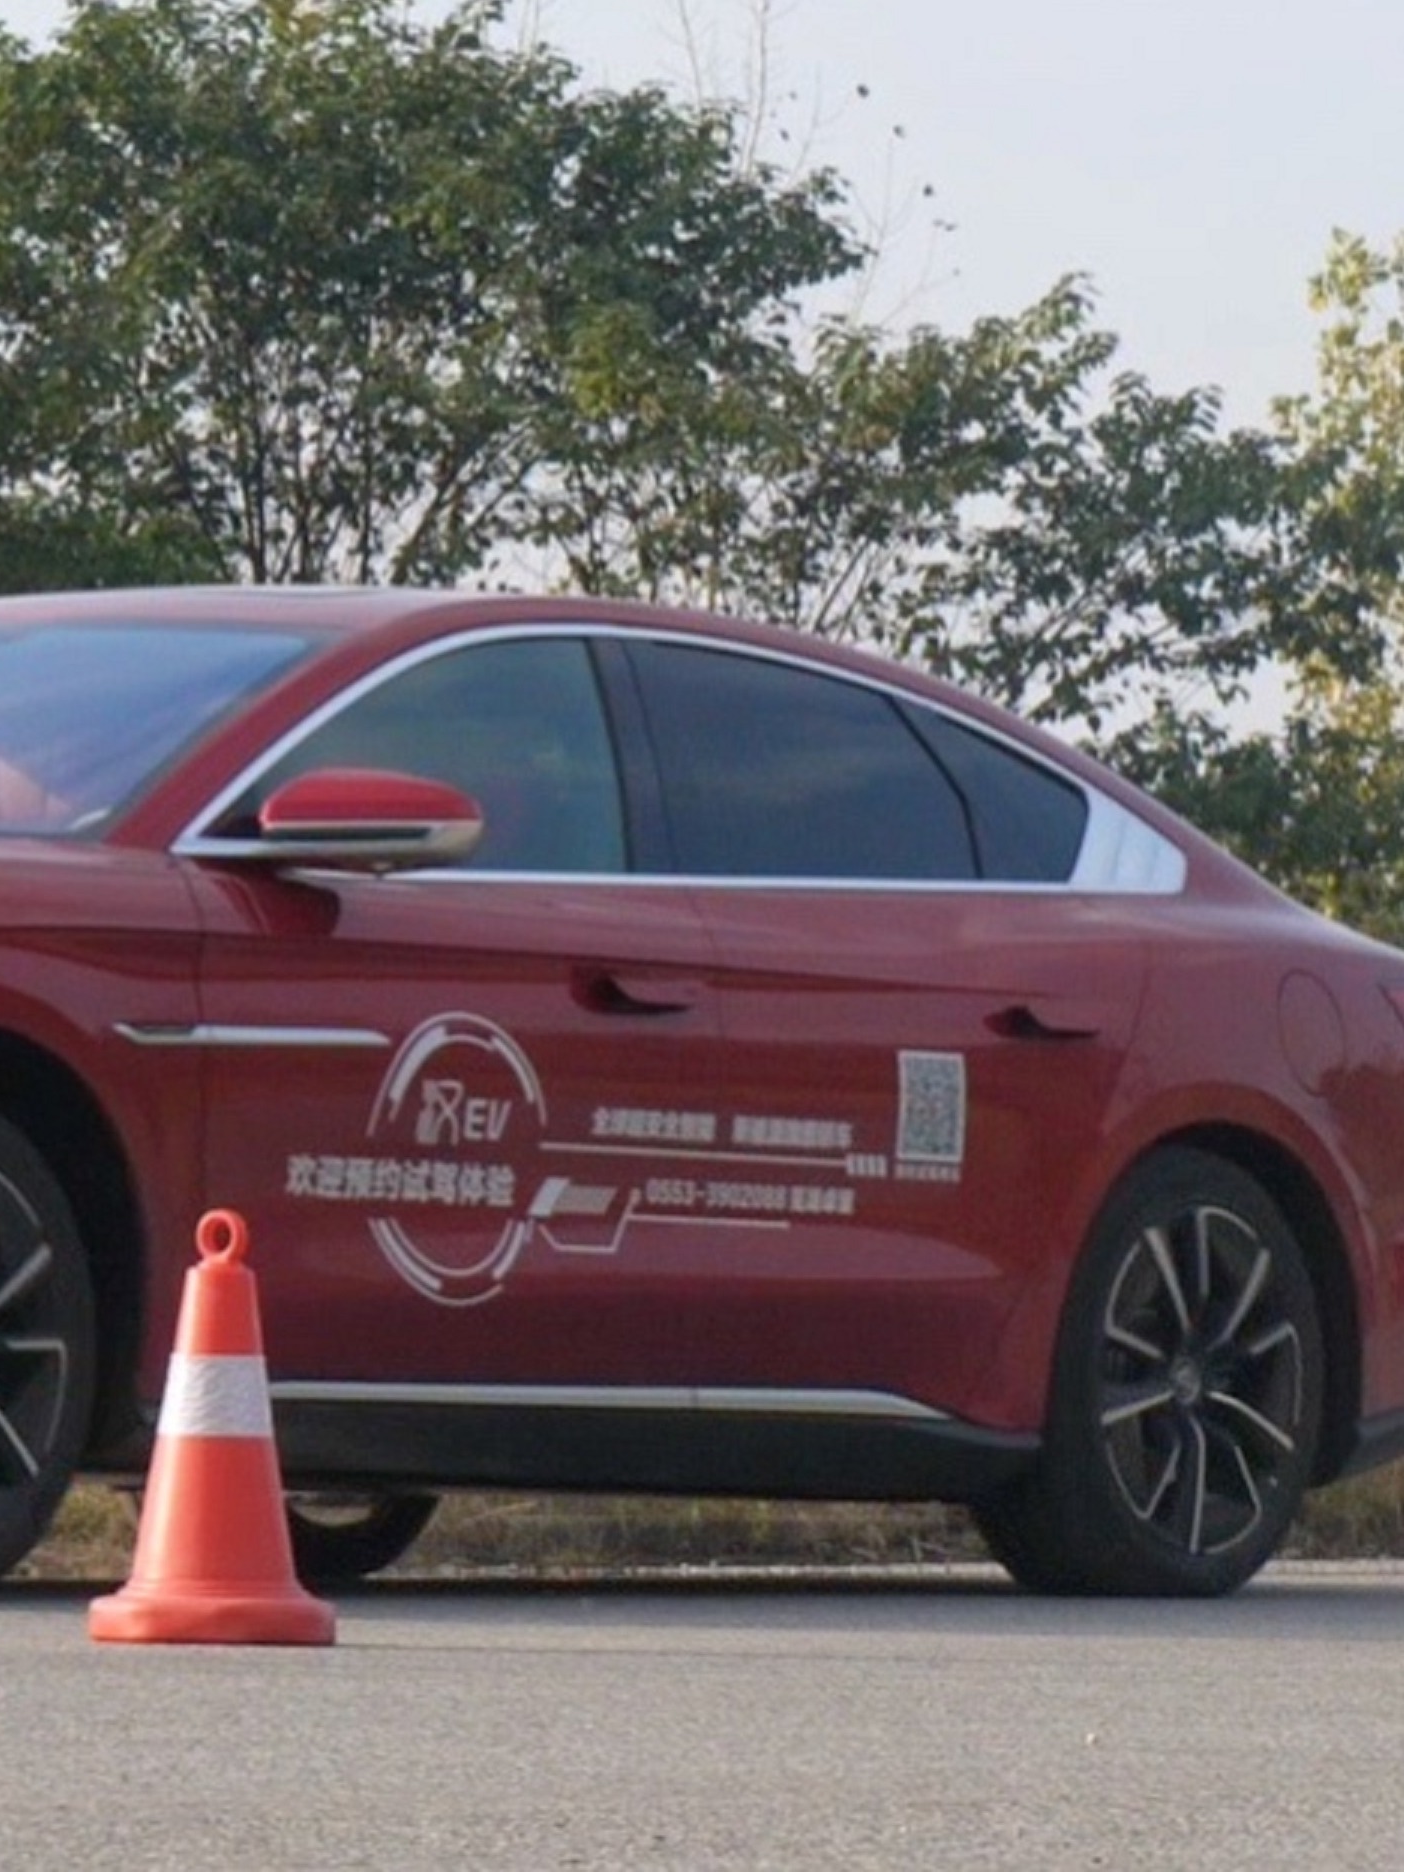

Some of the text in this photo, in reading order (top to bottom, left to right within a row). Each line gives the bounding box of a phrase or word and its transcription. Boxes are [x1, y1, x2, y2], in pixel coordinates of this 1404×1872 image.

[285, 1155, 515, 1206] 欢迎预约试驾体验
